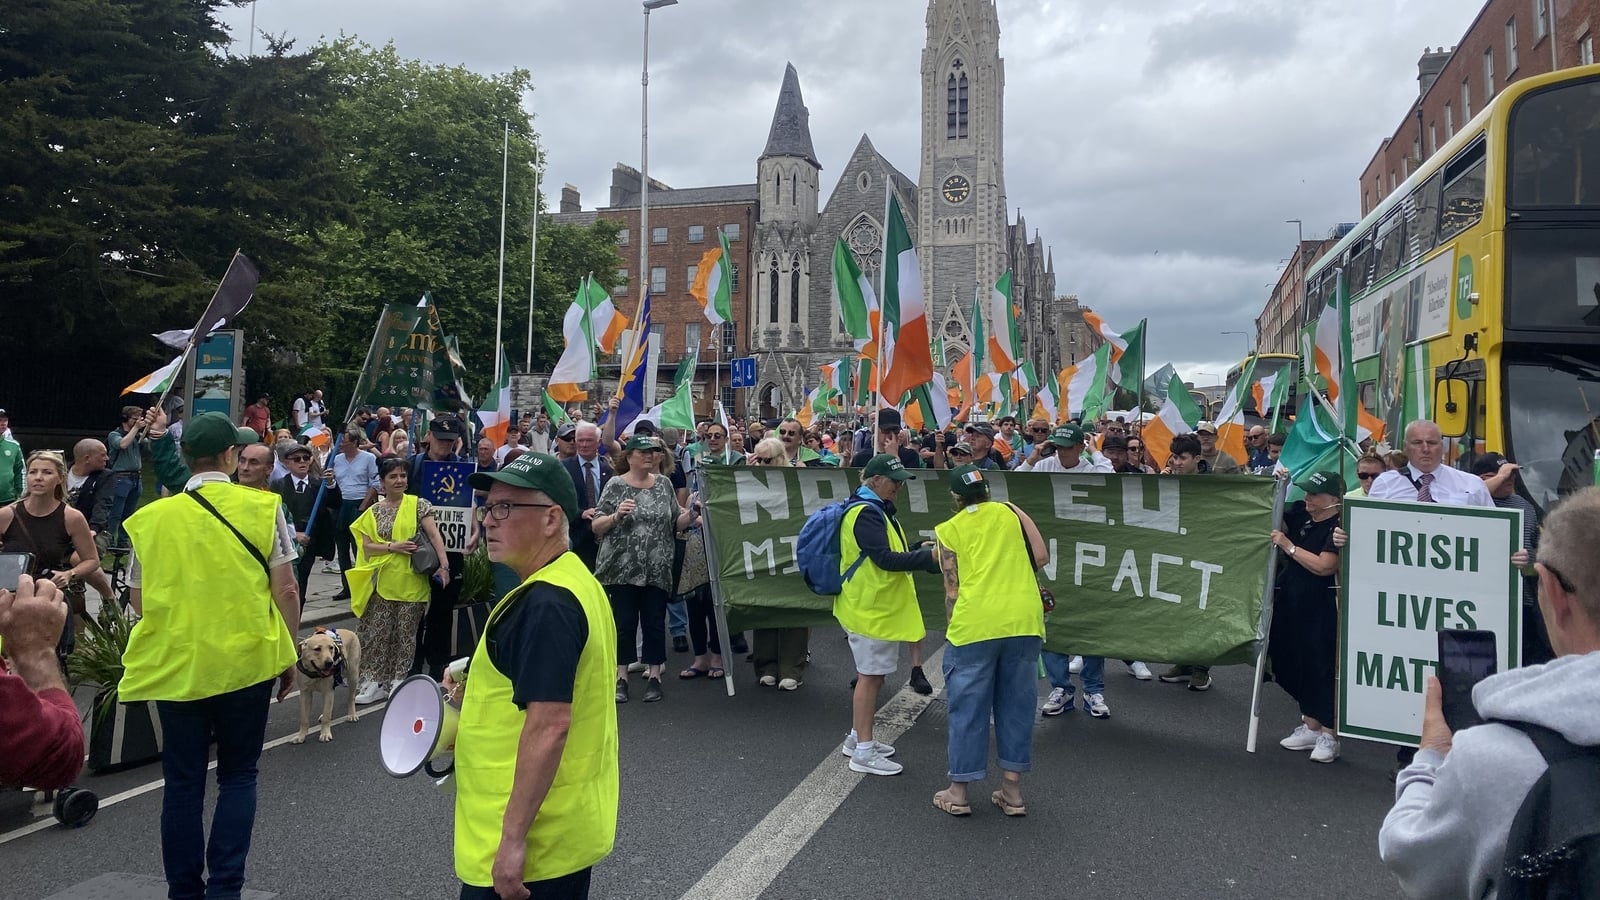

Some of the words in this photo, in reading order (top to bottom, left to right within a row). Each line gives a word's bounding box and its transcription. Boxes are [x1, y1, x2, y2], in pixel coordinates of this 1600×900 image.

[1459, 273, 1472, 299] TFI
[433, 509, 443, 522] CK
[444, 510, 452, 522] IN
[453, 510, 464, 522] THE
[733, 470, 852, 525] NO
[1050, 473, 1188, 535] E.U.
[436, 522, 466, 550] SSR
[1376, 529, 1479, 573] IRISH
[1074, 541, 1224, 610] PACT
[1377, 591, 1478, 632] LIVES
